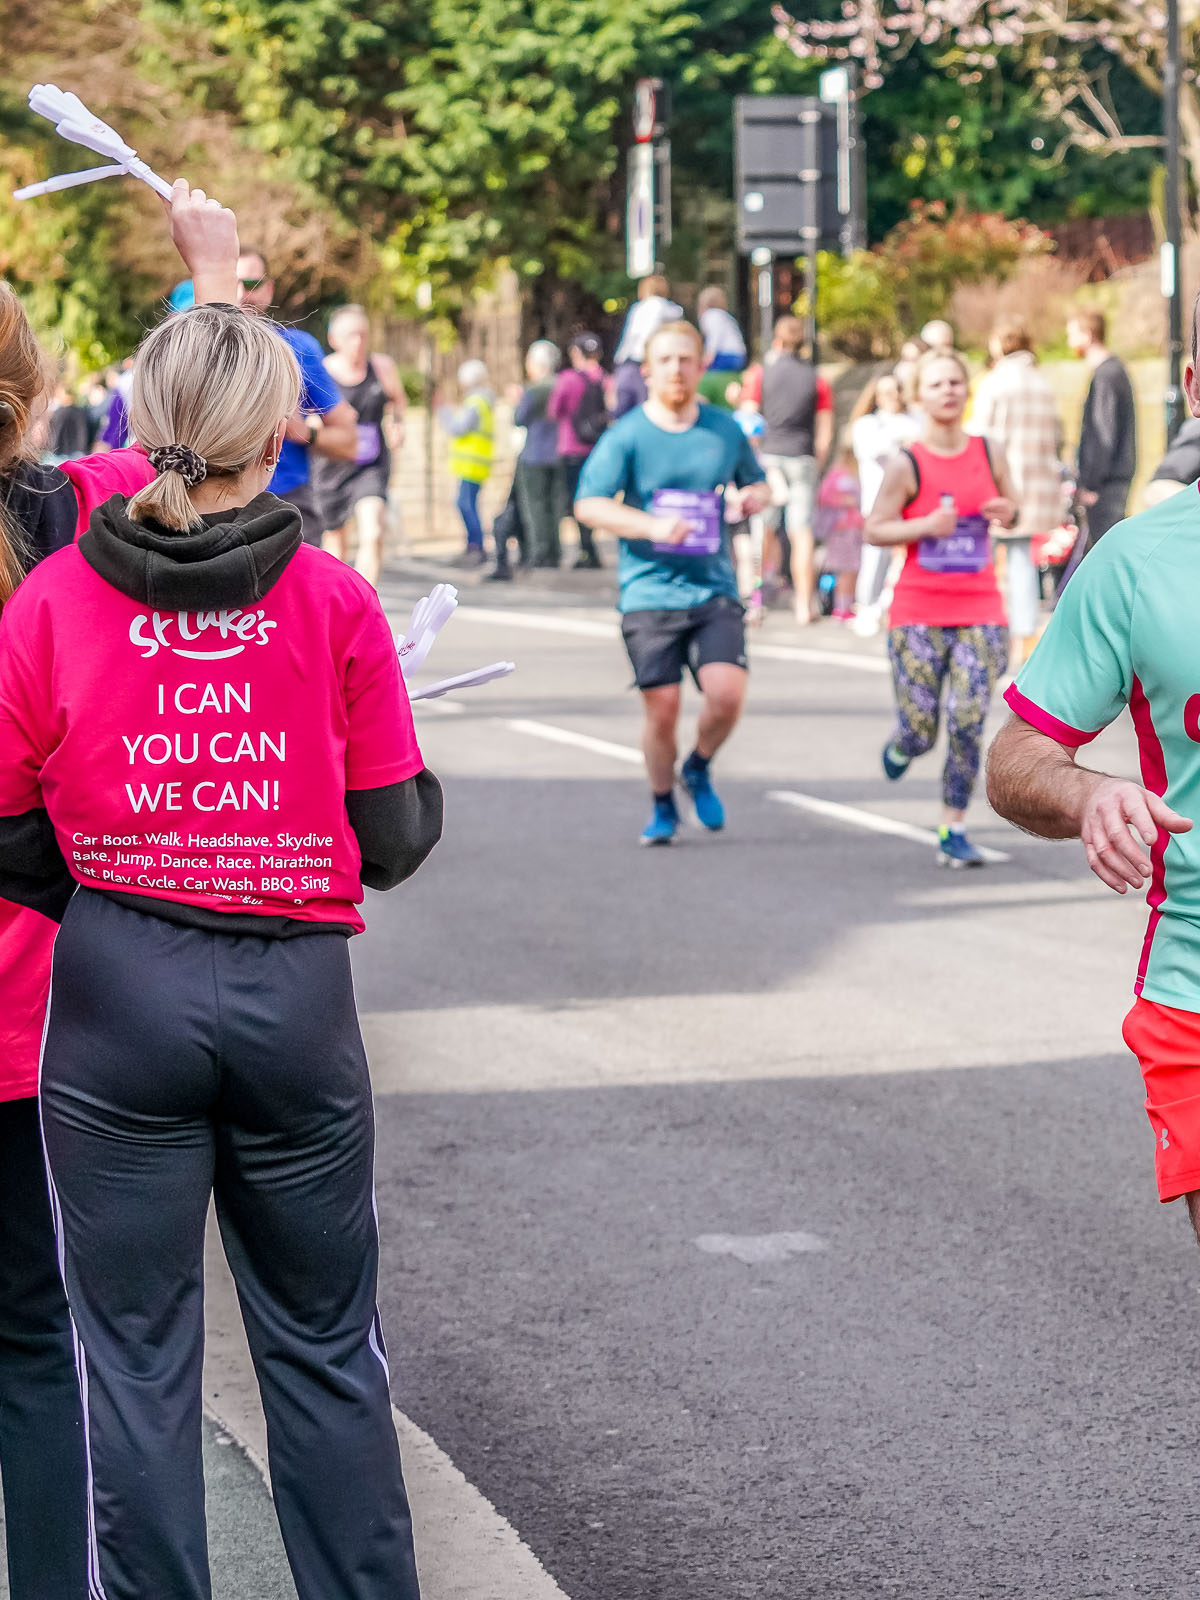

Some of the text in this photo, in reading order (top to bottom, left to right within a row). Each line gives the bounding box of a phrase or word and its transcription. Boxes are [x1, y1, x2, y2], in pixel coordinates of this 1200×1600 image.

[129, 609, 277, 658] St Luke's
[158, 682, 251, 715] I CAN
[121, 731, 286, 765] YOU CAN
[125, 780, 280, 814] WE CAN!
[72, 831, 333, 851] Car Boot. Walk. Headshave. Skydive
[72, 850, 332, 870] Bake. Jump. Dance. Race. Marathon
[183, 877, 209, 890] Car
[212, 876, 257, 891] Wash.
[261, 877, 298, 893] BBQ.
[301, 875, 330, 892] Sing
